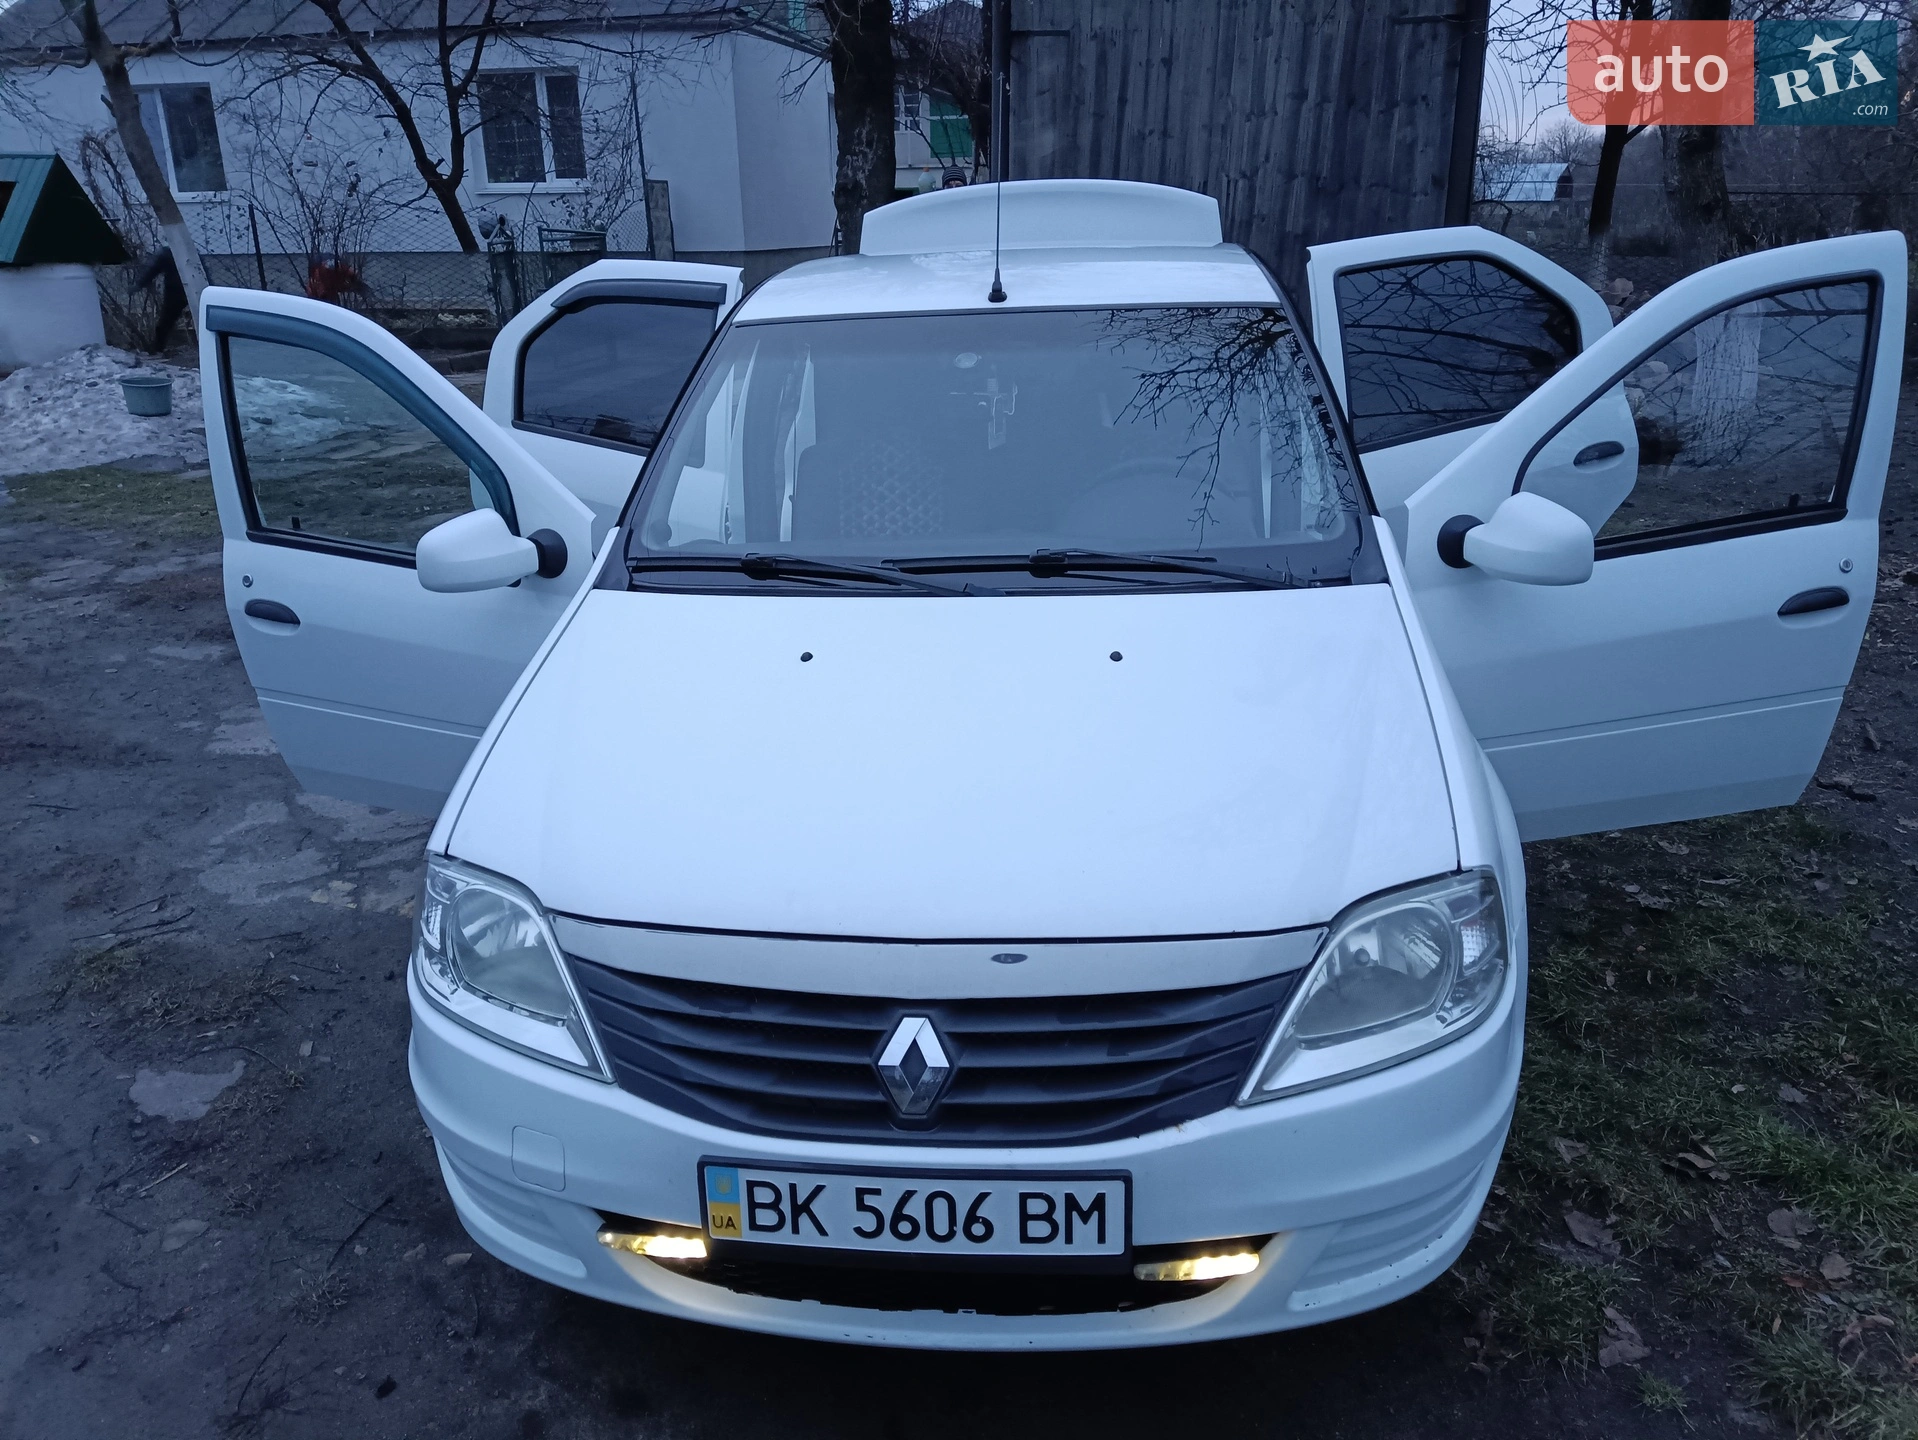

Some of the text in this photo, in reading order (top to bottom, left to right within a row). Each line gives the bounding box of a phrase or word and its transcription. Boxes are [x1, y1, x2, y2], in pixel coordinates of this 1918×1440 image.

[712, 1214, 737, 1230] UA
[745, 1179, 1107, 1245] BK 5606 BM
